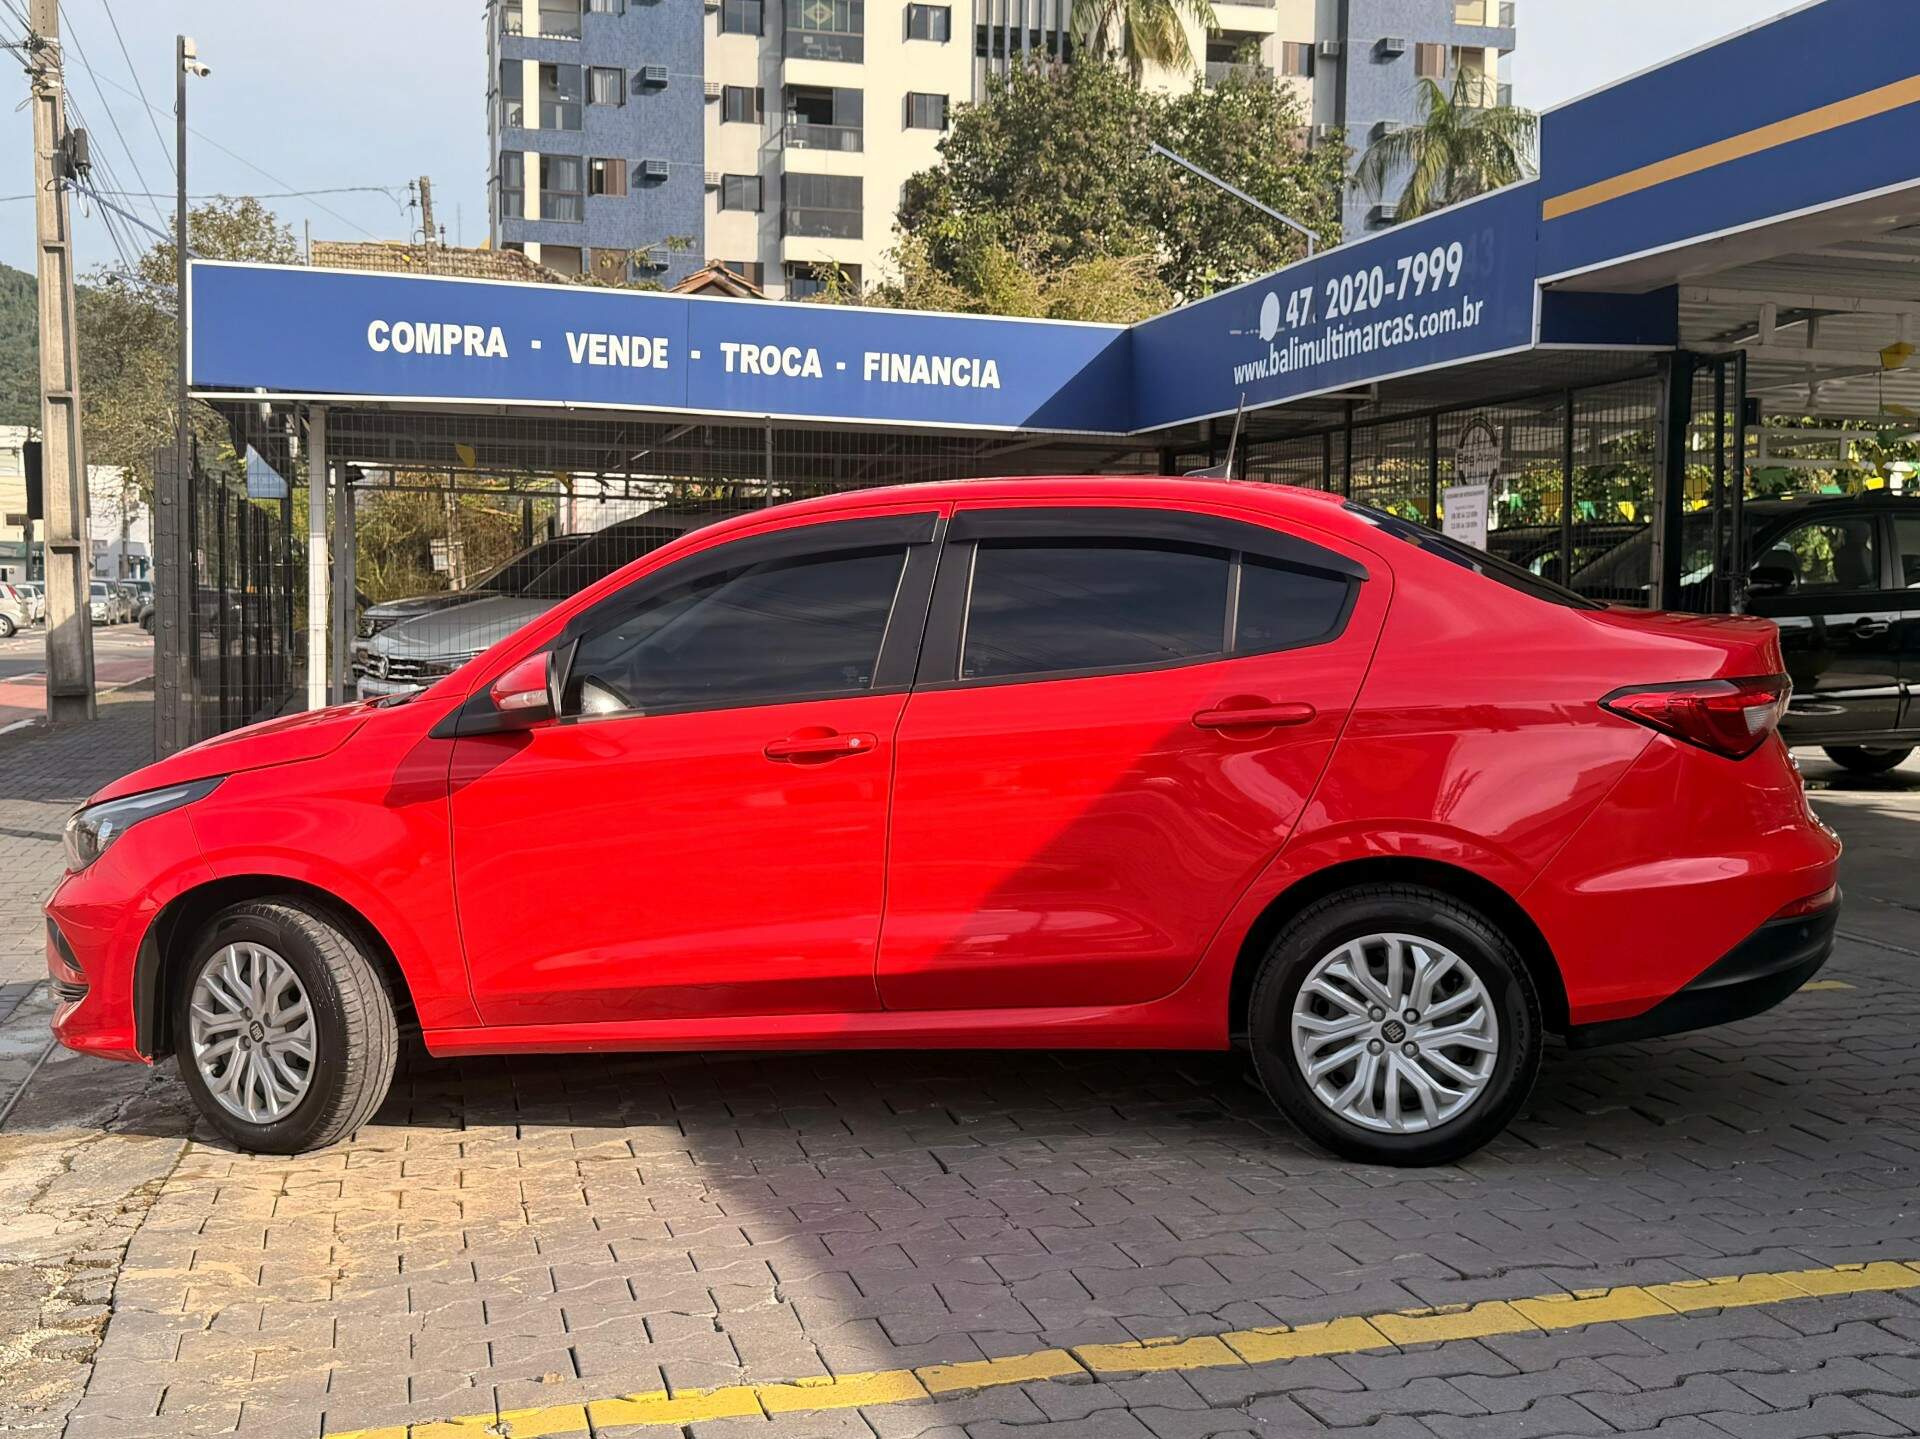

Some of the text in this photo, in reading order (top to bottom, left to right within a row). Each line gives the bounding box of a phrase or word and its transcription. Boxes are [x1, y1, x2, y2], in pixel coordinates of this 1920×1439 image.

[1325, 242, 1463, 320] 2020-7999
[367, 319, 509, 358] COMPRA
[566, 332, 669, 369] VENDE
[719, 342, 823, 379] TROCA
[863, 351, 1001, 389] FINANCIA
[1233, 296, 1485, 385] www.balimultimarcas.com.br
